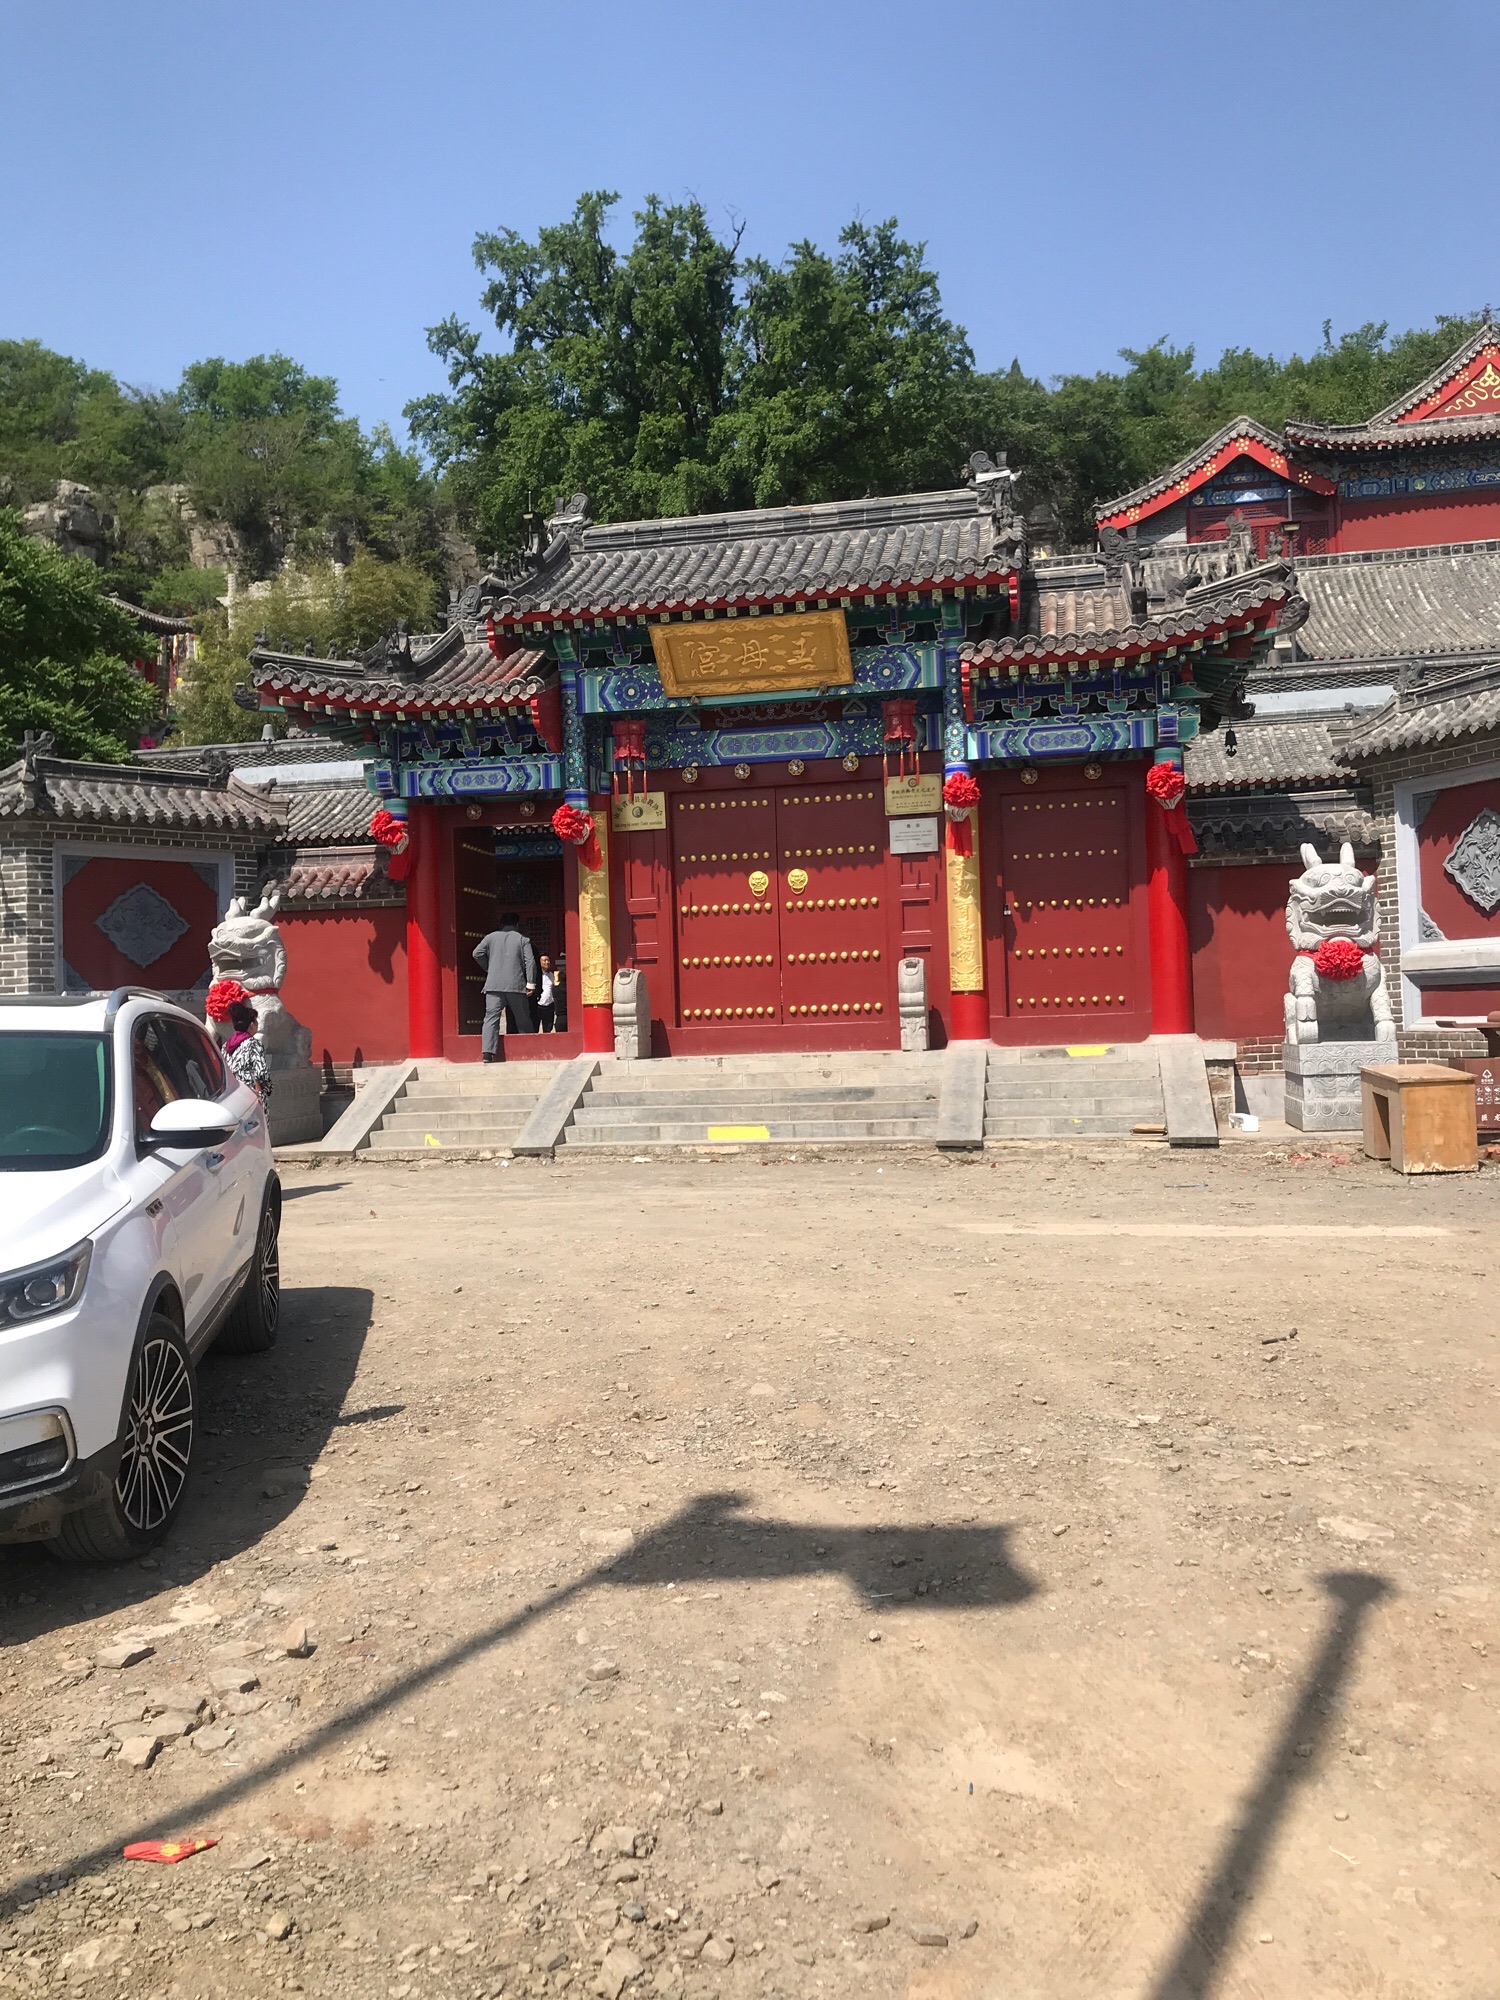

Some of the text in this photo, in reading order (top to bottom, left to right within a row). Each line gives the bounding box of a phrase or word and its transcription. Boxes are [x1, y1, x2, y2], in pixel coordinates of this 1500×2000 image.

[614, 795, 663, 820] 山东省县道教协会
